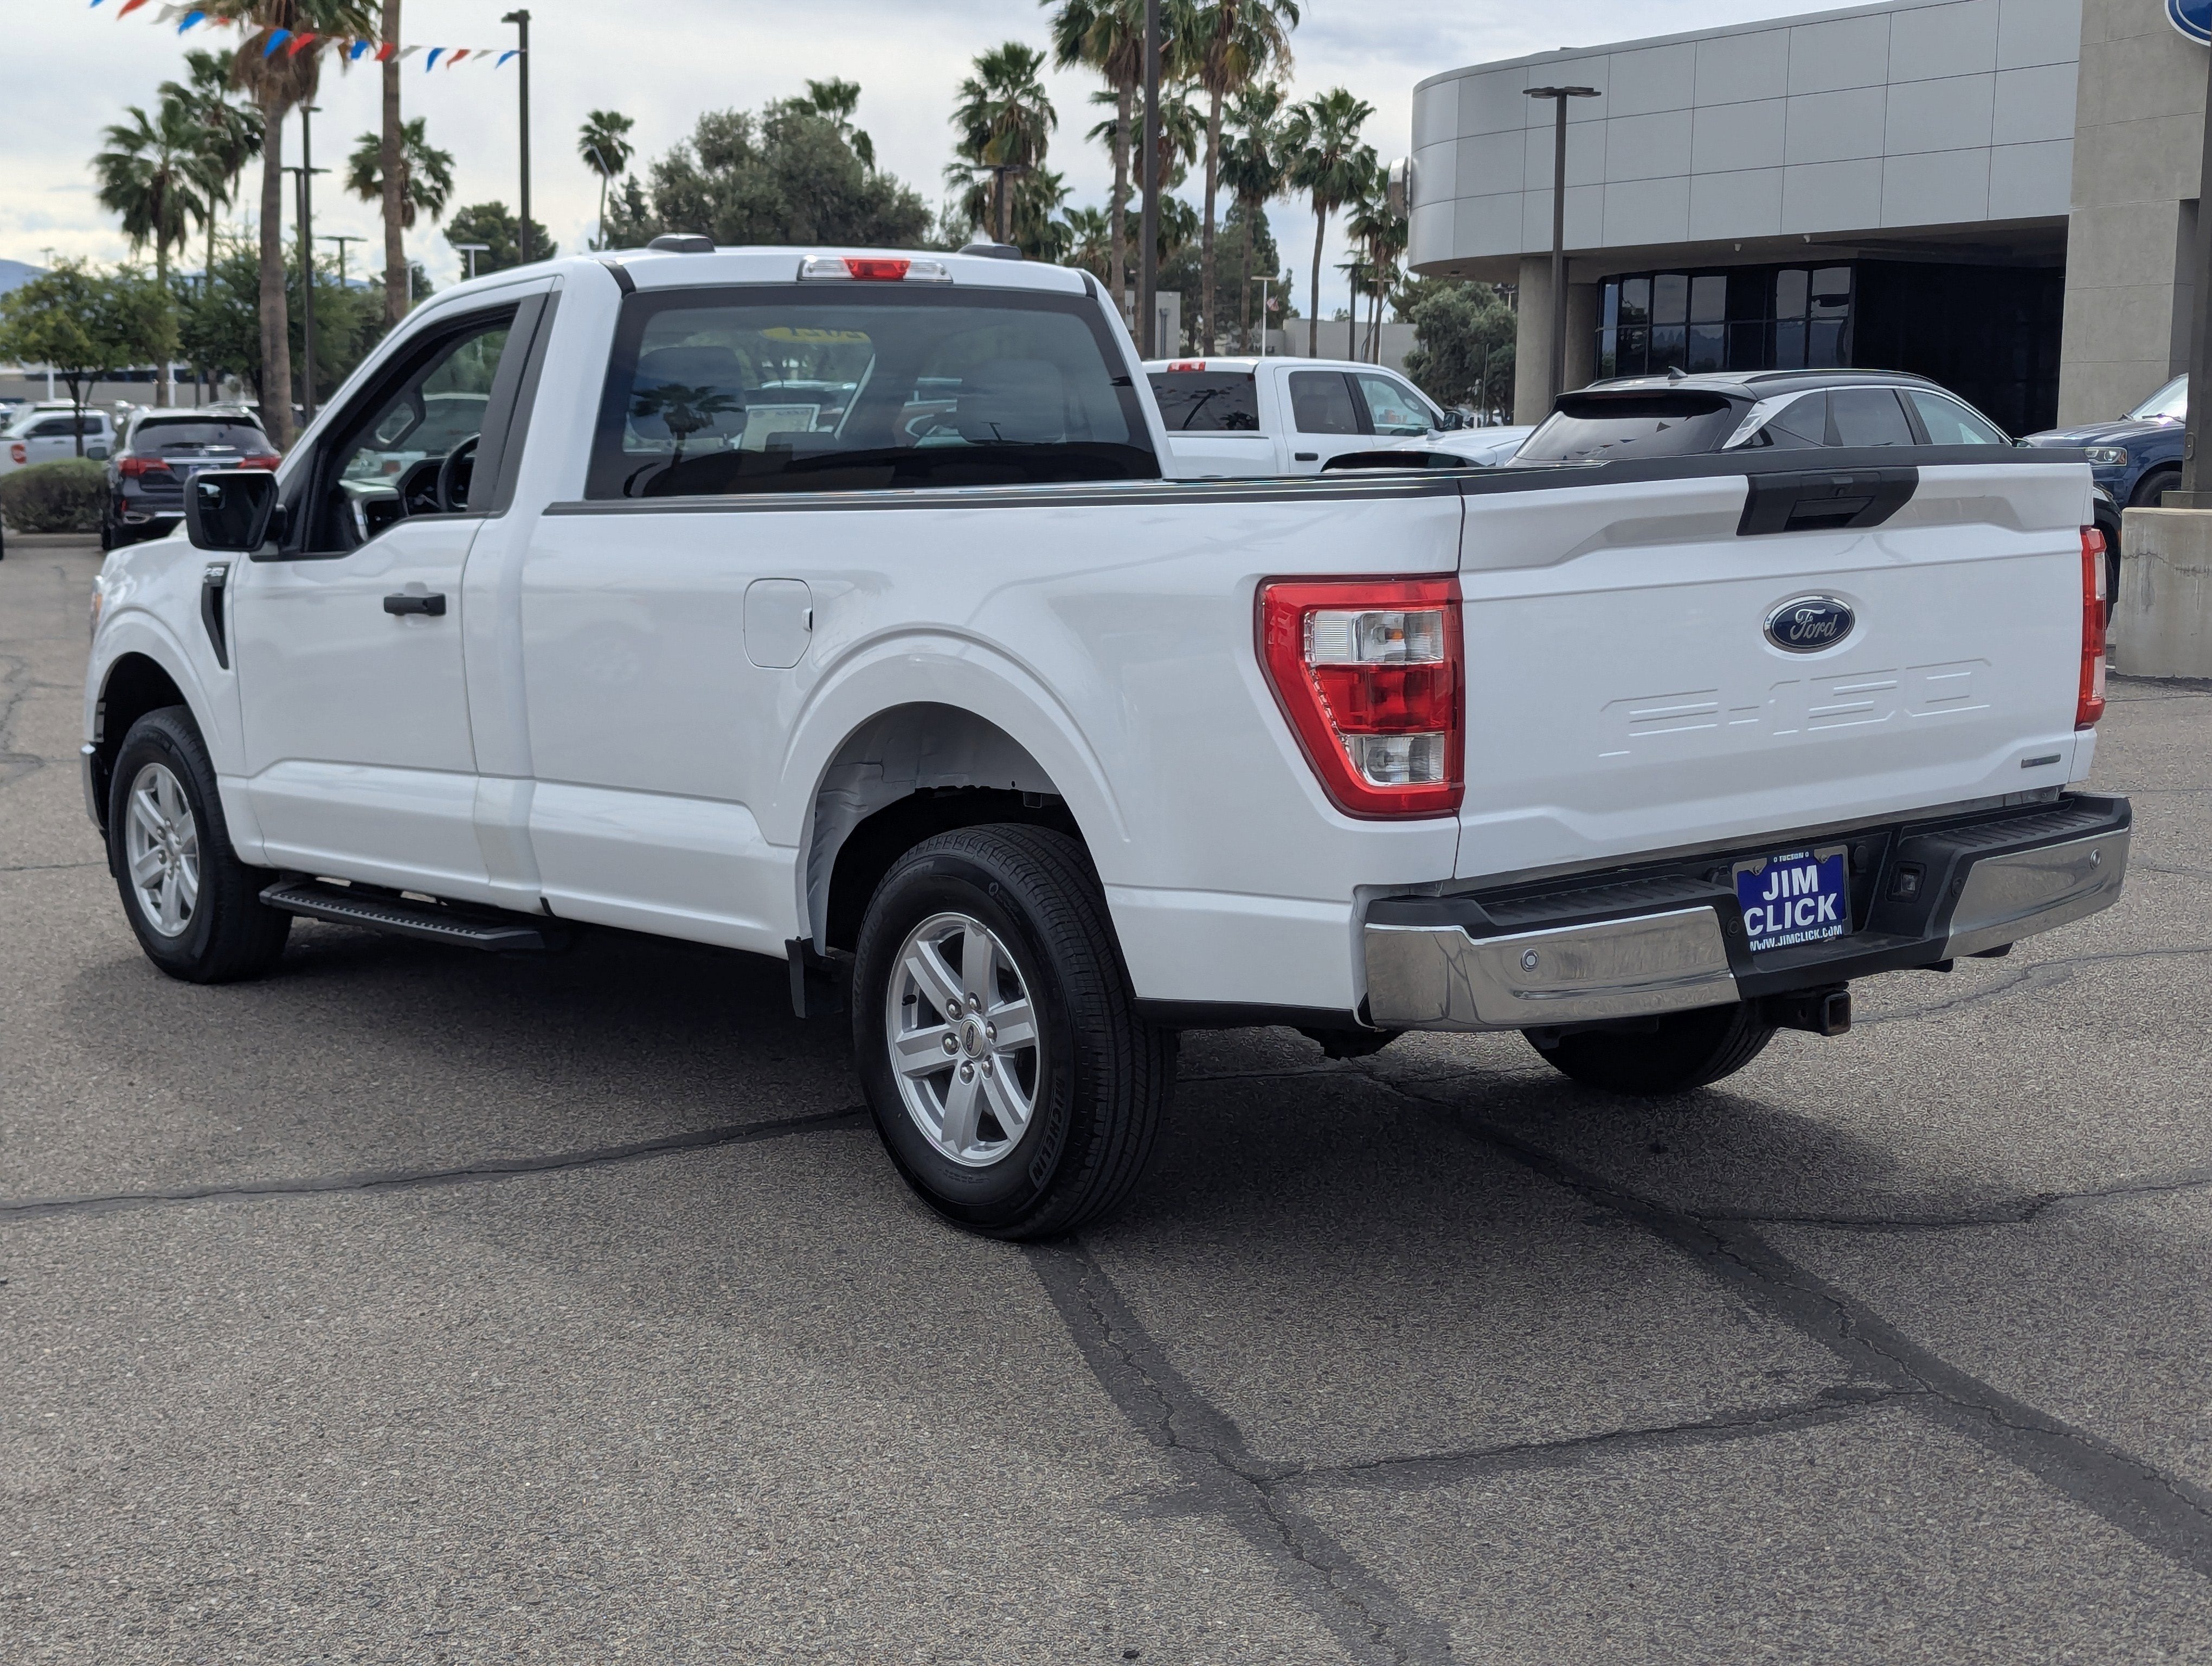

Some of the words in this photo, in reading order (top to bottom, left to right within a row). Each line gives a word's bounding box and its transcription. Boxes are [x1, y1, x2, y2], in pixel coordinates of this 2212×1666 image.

[1790, 608, 1838, 640] Ford
[1598, 657, 1992, 757] F-150
[1763, 864, 1818, 901] JIM
[1744, 893, 1837, 936] CLICK
[1750, 925, 1842, 951] WWW.JIMCLICK.COM
[1032, 1075, 1065, 1181] MICHELIN
